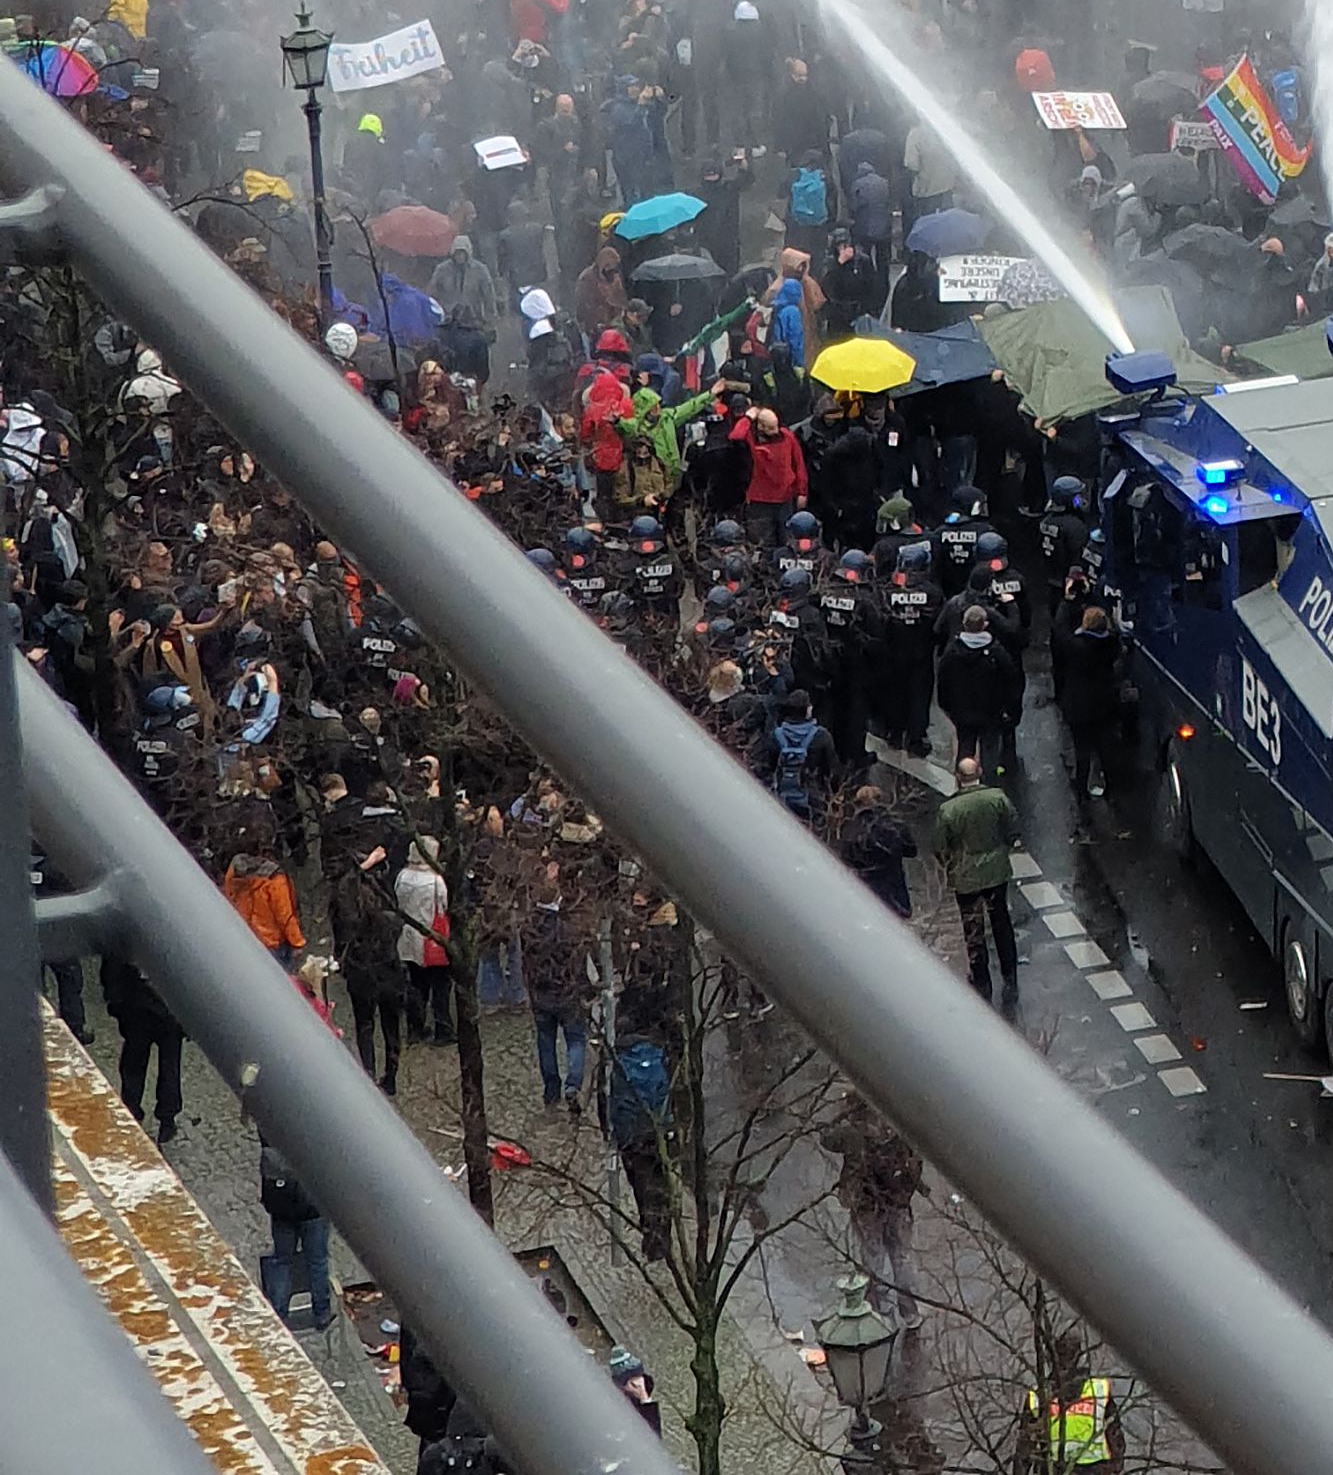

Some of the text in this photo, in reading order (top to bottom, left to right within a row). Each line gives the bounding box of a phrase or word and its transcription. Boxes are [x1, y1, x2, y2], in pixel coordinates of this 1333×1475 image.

[941, 530, 977, 543] POLIZEI
[821, 596, 855, 610] POLIZEI
[891, 592, 927, 605] POLIZEI
[1241, 657, 1283, 767] BE3
